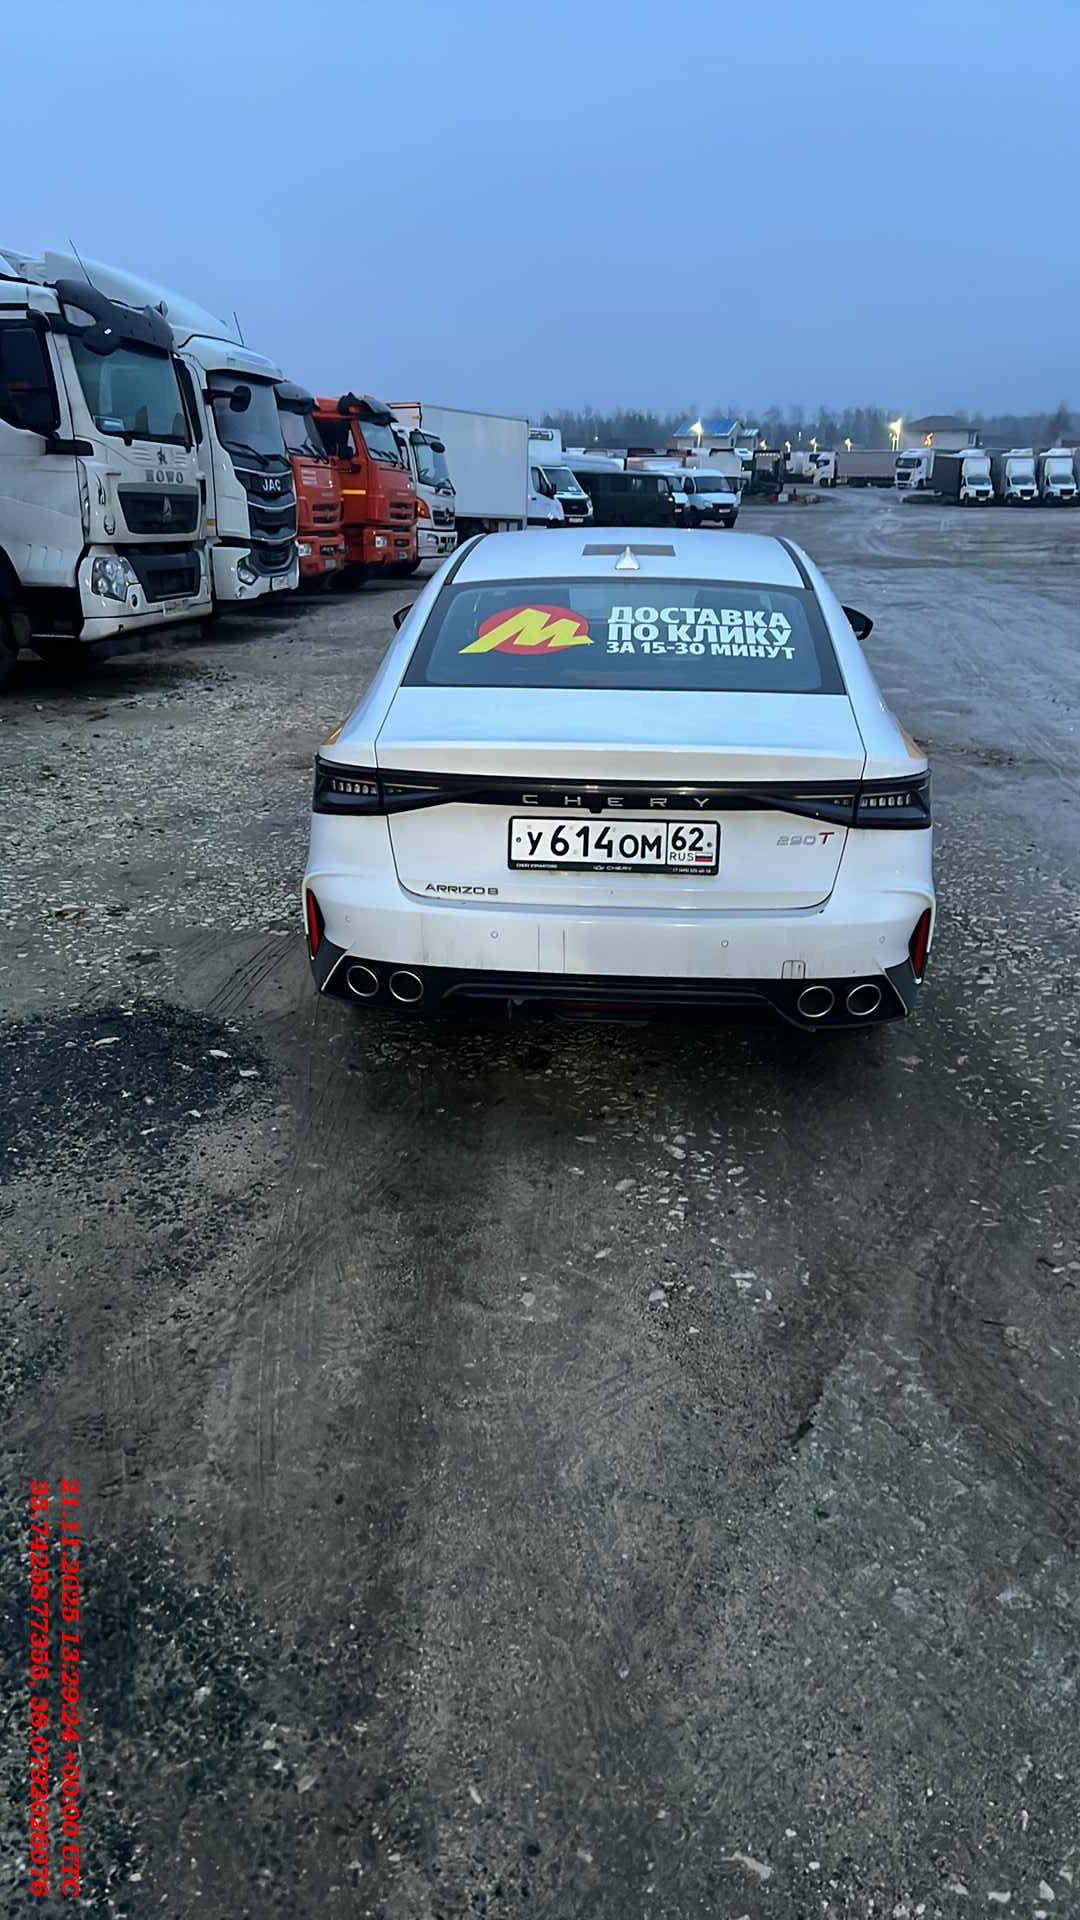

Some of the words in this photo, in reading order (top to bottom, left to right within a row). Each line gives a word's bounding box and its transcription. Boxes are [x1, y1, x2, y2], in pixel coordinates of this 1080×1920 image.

[145, 469, 184, 485] HOWO
[262, 478, 282, 492] JAC
[607, 606, 792, 629] ДОСТАВКА
[608, 623, 660, 641] ПО
[668, 625, 793, 647] КЛИКУ
[606, 641, 635, 654] ЗА
[640, 642, 705, 656] 15-30
[711, 642, 796, 660] МИНУТ
[522, 794, 710, 808] CHERY
[671, 826, 704, 852] 62
[776, 832, 835, 847] 290T
[669, 851, 694, 862] RUS
[425, 883, 485, 895] ARRIZO
[487, 887, 499, 896] 8
